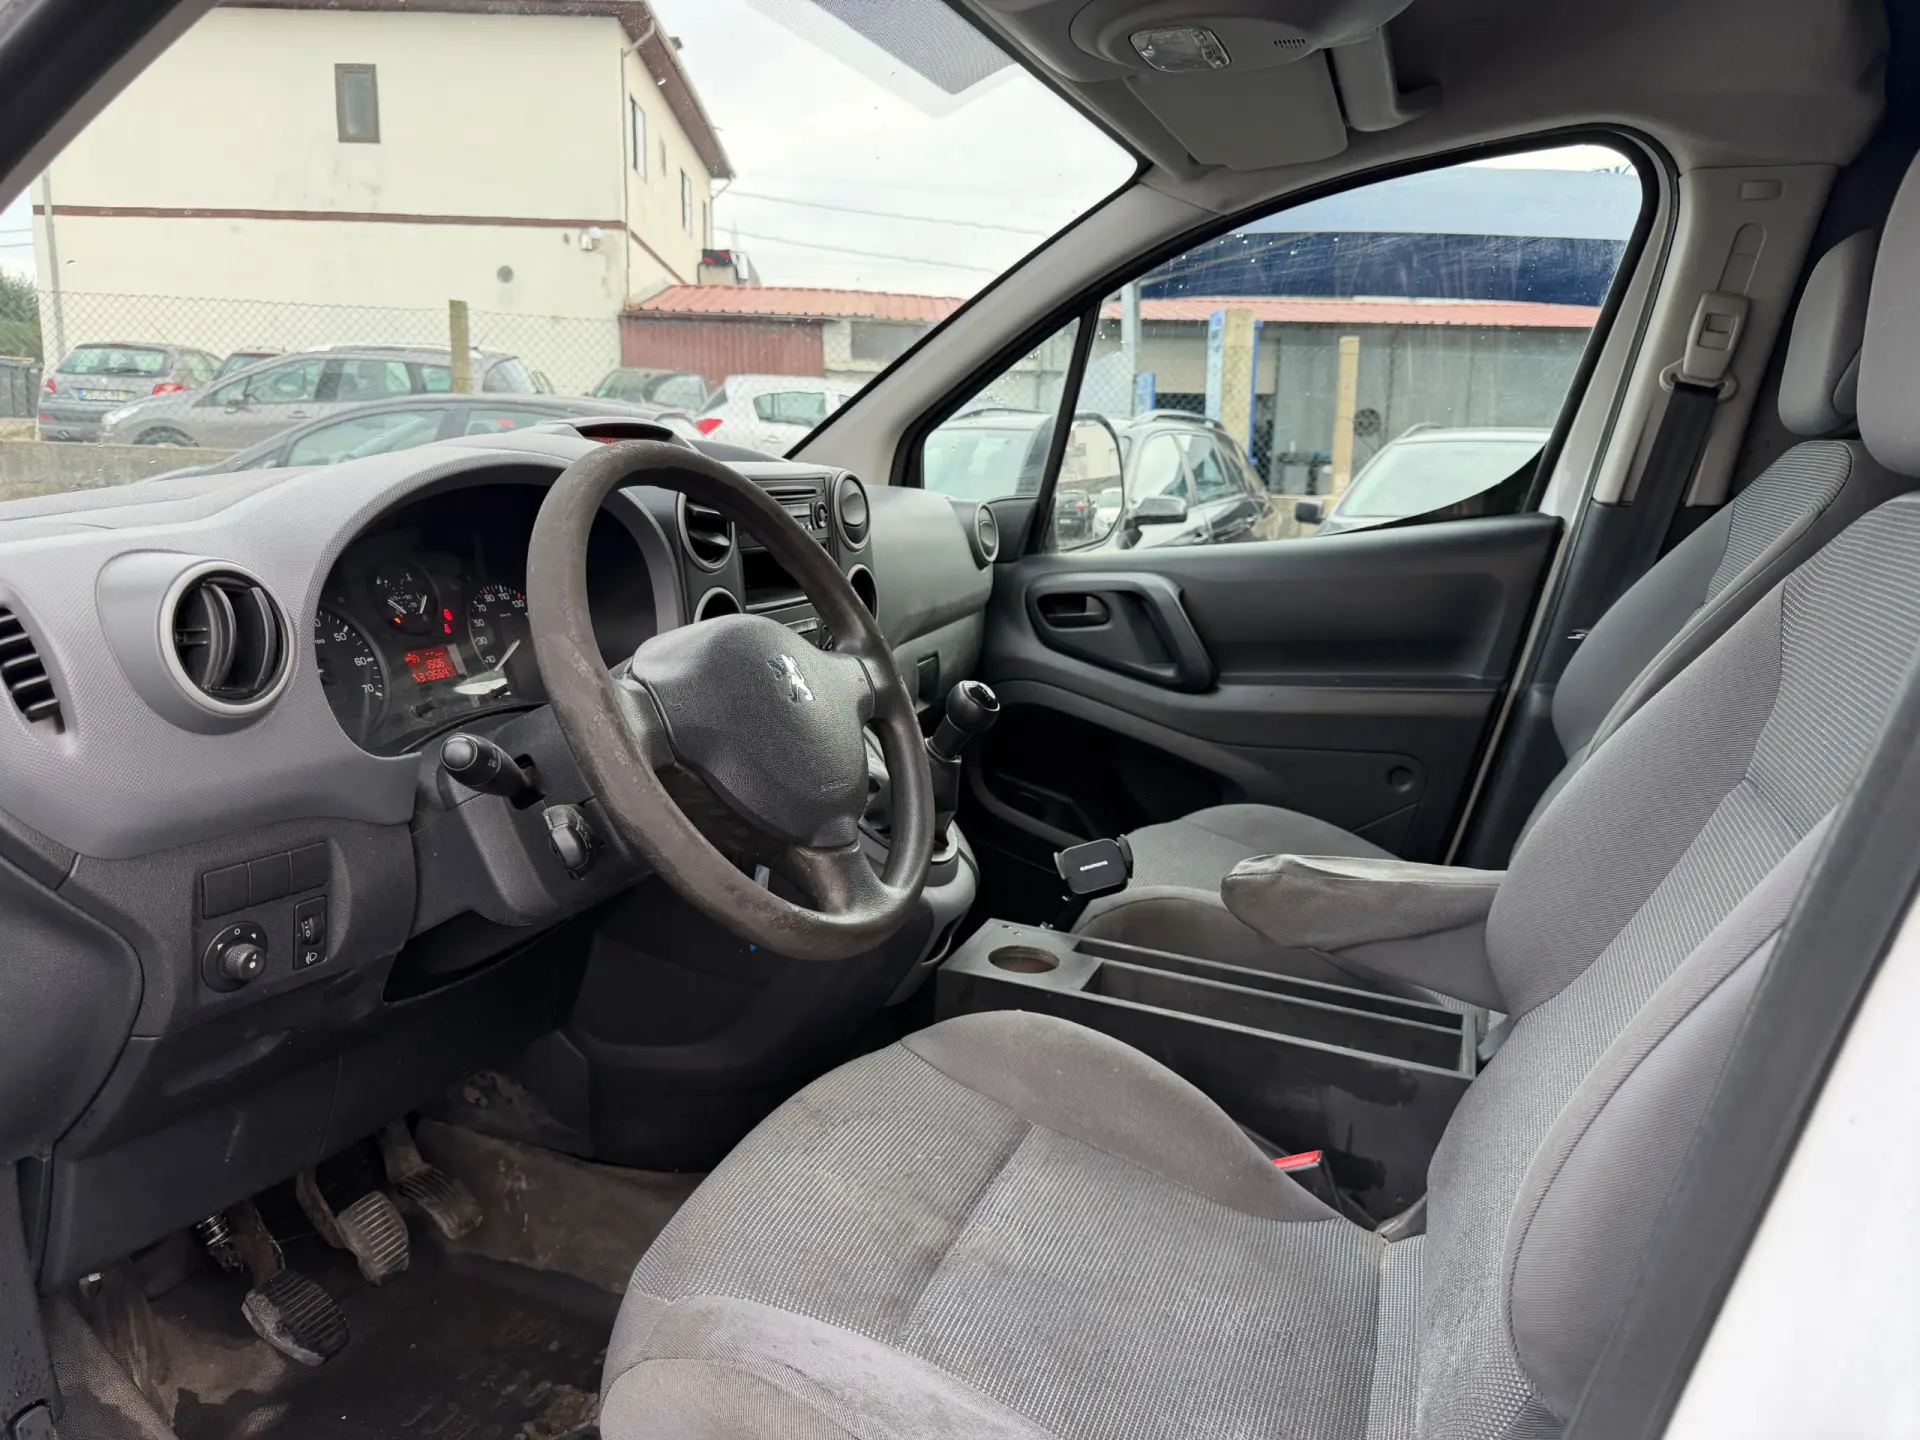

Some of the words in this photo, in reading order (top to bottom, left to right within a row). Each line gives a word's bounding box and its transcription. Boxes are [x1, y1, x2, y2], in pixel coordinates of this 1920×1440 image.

[498, 592, 510, 600] 110
[476, 604, 487, 612] 70
[512, 600, 525, 608] 130
[473, 619, 485, 627] 50
[333, 632, 347, 642] 50
[475, 636, 488, 645] 30
[354, 657, 367, 666] 60
[361, 684, 375, 693] 70
